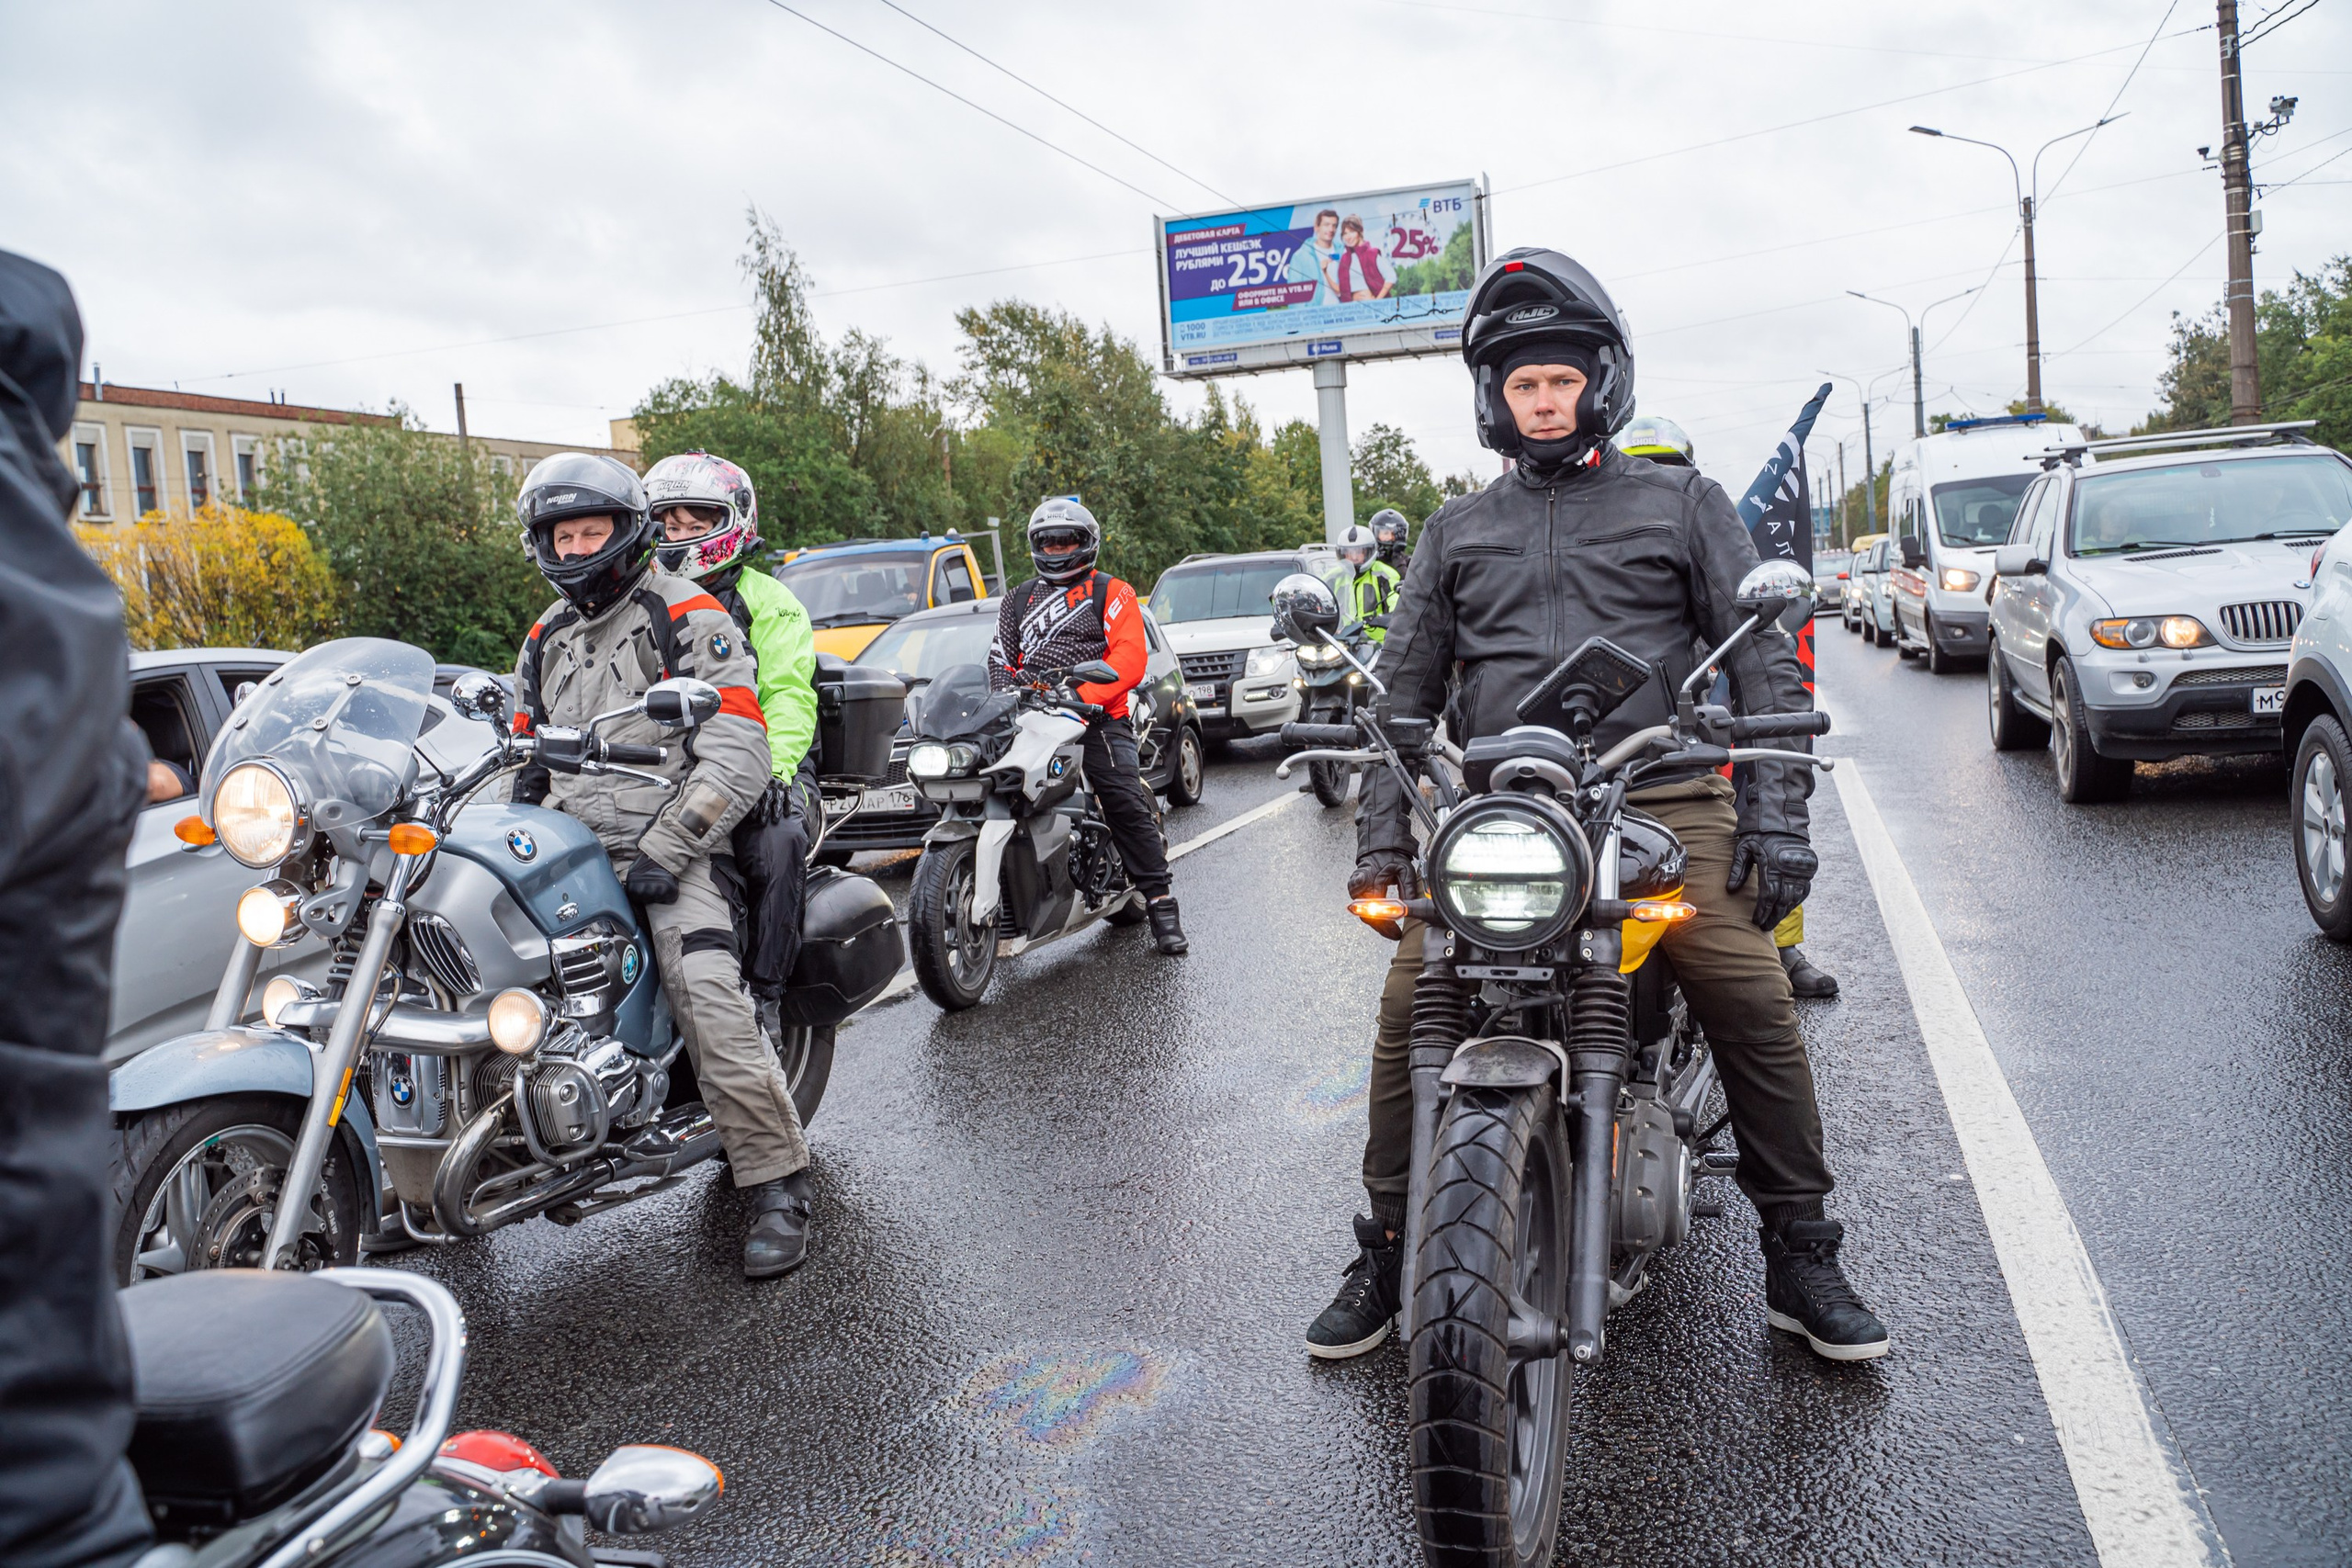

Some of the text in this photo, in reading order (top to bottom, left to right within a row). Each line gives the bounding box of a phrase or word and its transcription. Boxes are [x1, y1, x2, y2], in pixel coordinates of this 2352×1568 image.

[1433, 197, 1462, 213] ВТБ
[1216, 226, 1240, 237] КАРТА
[1175, 238, 1261, 260] ЛУЧШИЙ КЕШБЭК
[1391, 227, 1439, 259] 25%
[1175, 255, 1224, 272] РУБЛЯМИ
[1227, 247, 1291, 288] 25%
[1511, 308, 1553, 321] HJC
[1186, 322, 1205, 331] 1000
[546, 492, 577, 505] NOLAN
